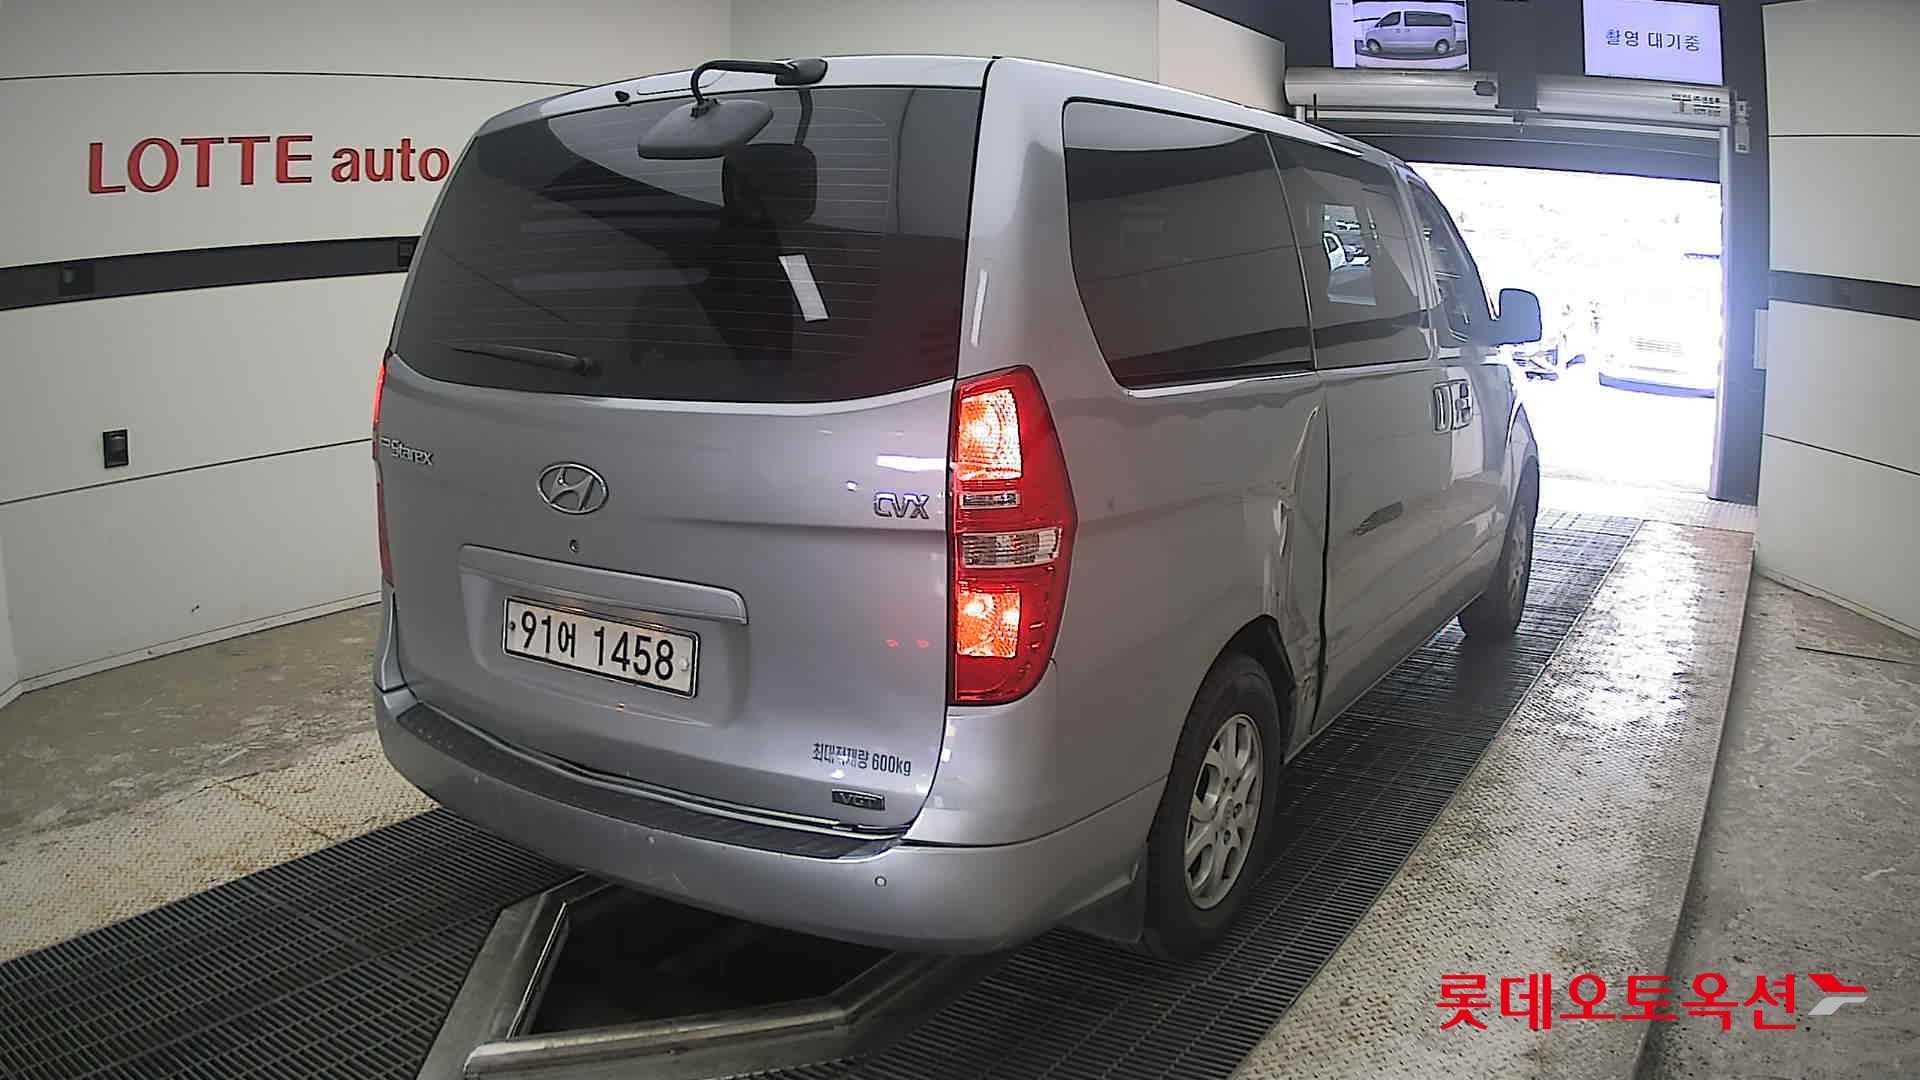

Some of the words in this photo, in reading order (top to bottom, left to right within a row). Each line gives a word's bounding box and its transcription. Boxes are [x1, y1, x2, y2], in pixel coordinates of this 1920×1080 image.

[1646, 31, 1700, 52] 대기중
[88, 135, 313, 194] LOTTE
[331, 138, 450, 183] auto
[873, 492, 930, 520] CVX
[521, 611, 577, 658] 91어
[594, 626, 674, 681] 1458
[872, 753, 912, 777] 600kg
